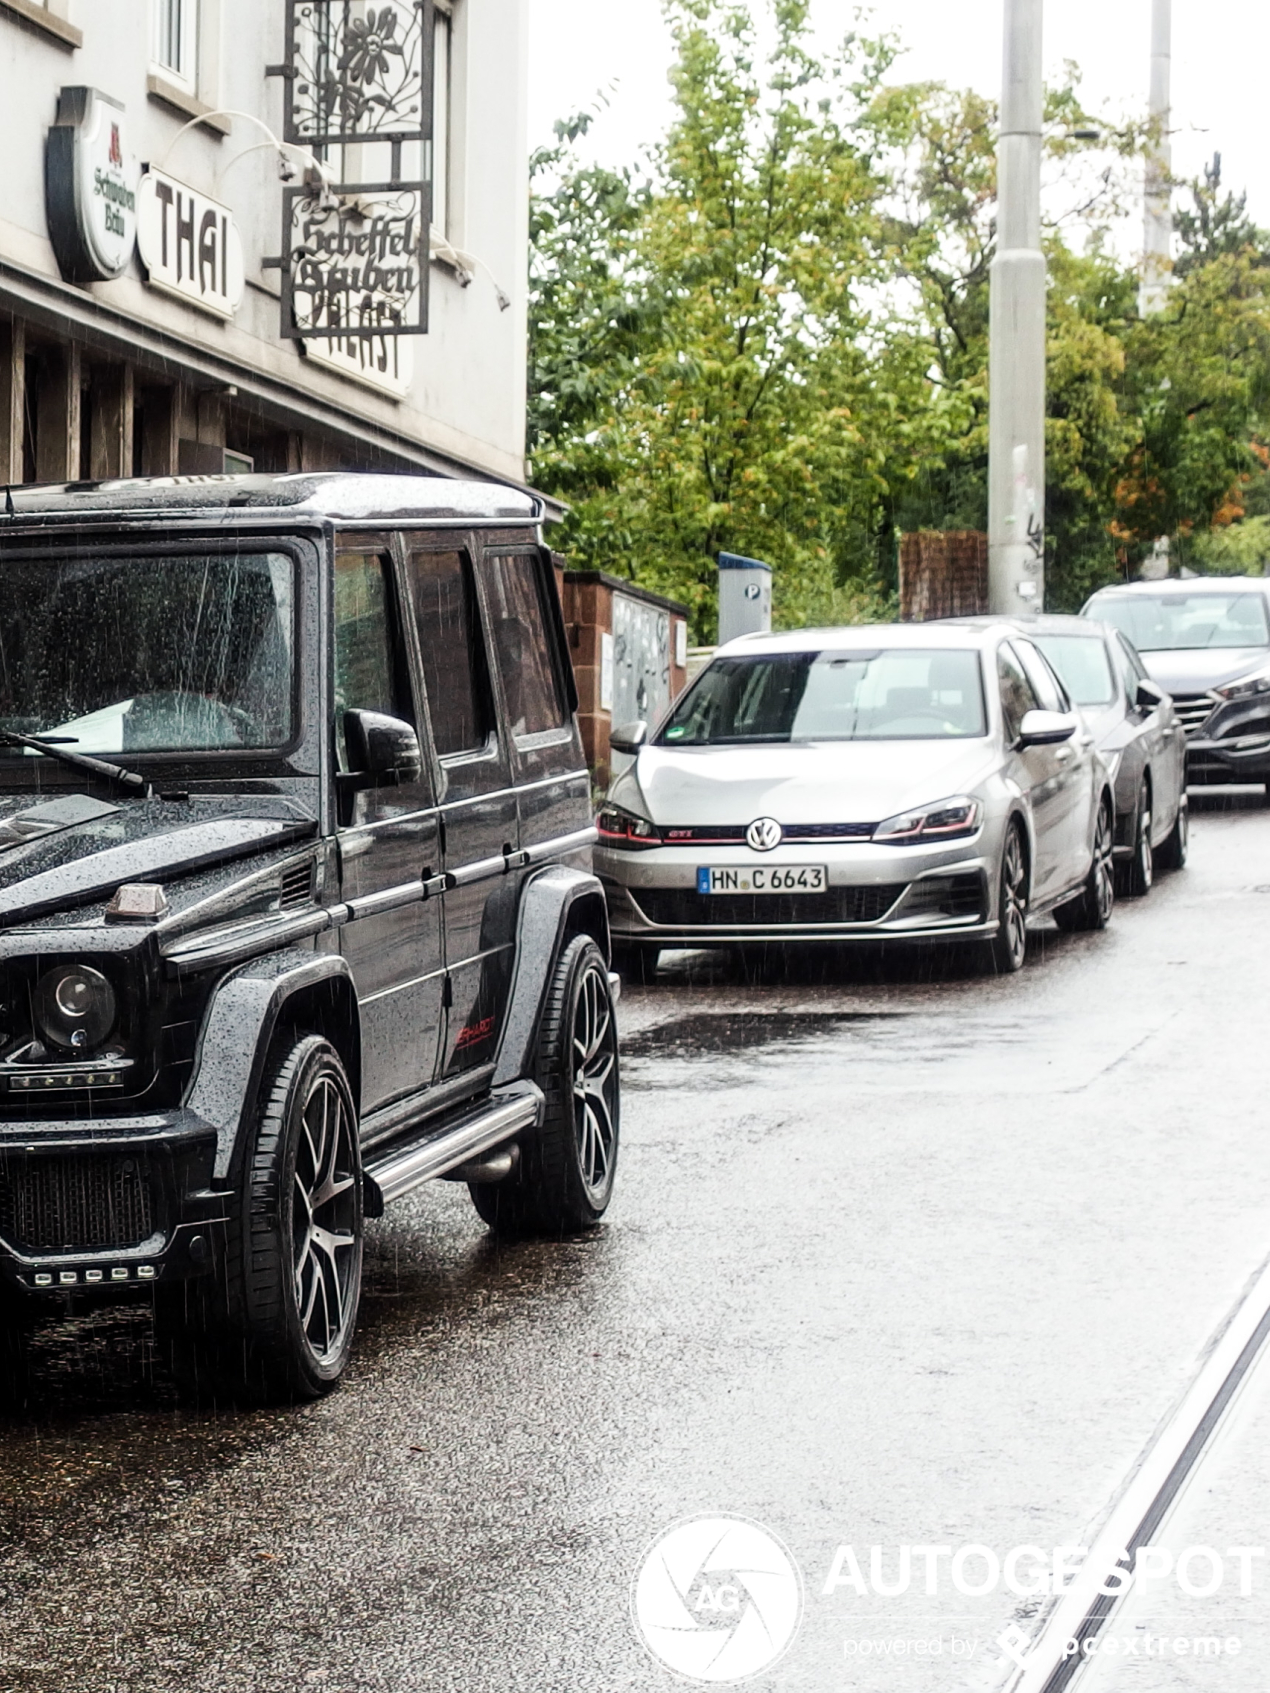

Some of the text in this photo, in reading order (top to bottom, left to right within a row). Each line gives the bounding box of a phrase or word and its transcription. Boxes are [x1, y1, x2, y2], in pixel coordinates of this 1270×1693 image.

[94, 167, 136, 213] Schwaben
[155, 180, 228, 298] THAI
[294, 213, 419, 263] Scheffel
[294, 254, 420, 295] Stuben
[668, 830, 693, 838] GTI
[712, 868, 822, 889] HN C 6643
